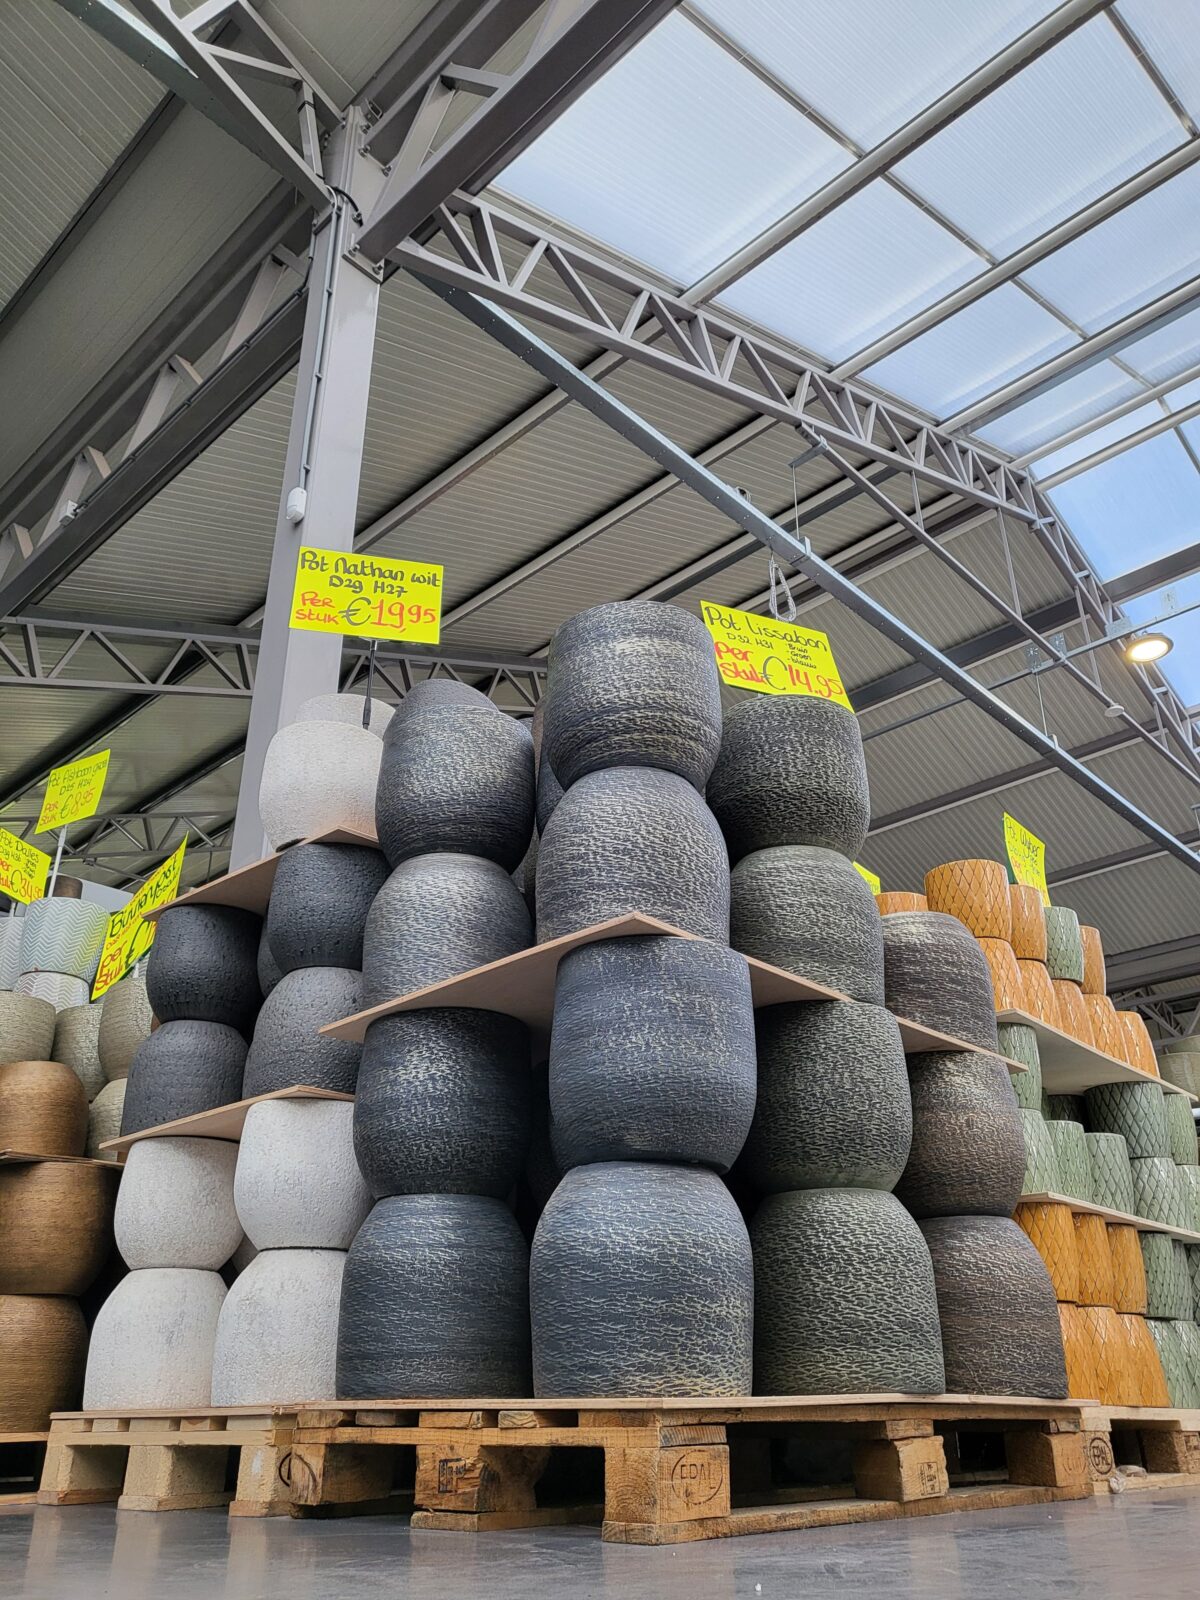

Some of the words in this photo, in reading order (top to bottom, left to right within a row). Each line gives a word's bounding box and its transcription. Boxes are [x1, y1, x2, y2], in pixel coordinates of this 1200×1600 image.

[300, 550, 329, 573] Pot
[334, 556, 405, 582] Nathan
[410, 571, 441, 588] wit
[329, 575, 364, 594] D29
[373, 580, 408, 598] H27
[704, 606, 741, 631] Pot
[726, 632, 752, 646] D32
